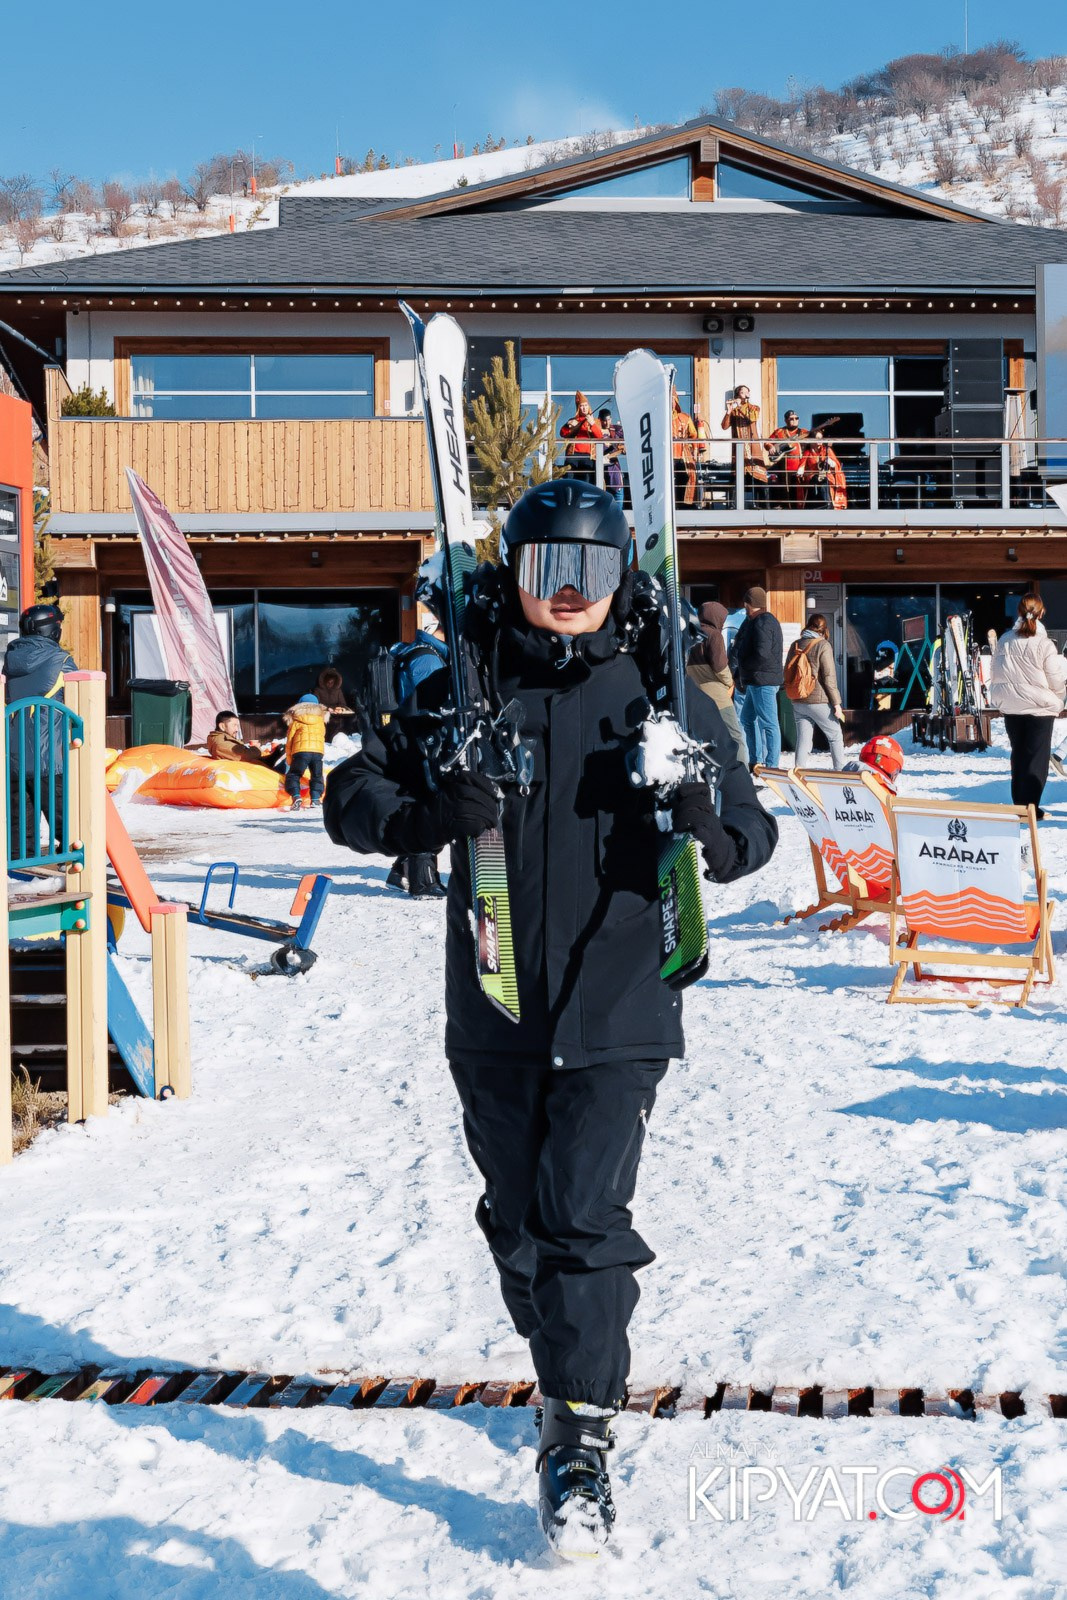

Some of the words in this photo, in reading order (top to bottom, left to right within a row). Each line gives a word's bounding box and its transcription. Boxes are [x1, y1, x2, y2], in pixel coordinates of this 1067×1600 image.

[439, 374, 466, 496] HEAD
[640, 412, 655, 501] HEAD
[834, 807, 876, 823] ARARAT
[918, 841, 1000, 865] ARARAT
[485, 916, 498, 973] SHAPE
[661, 898, 676, 953] SHAPE
